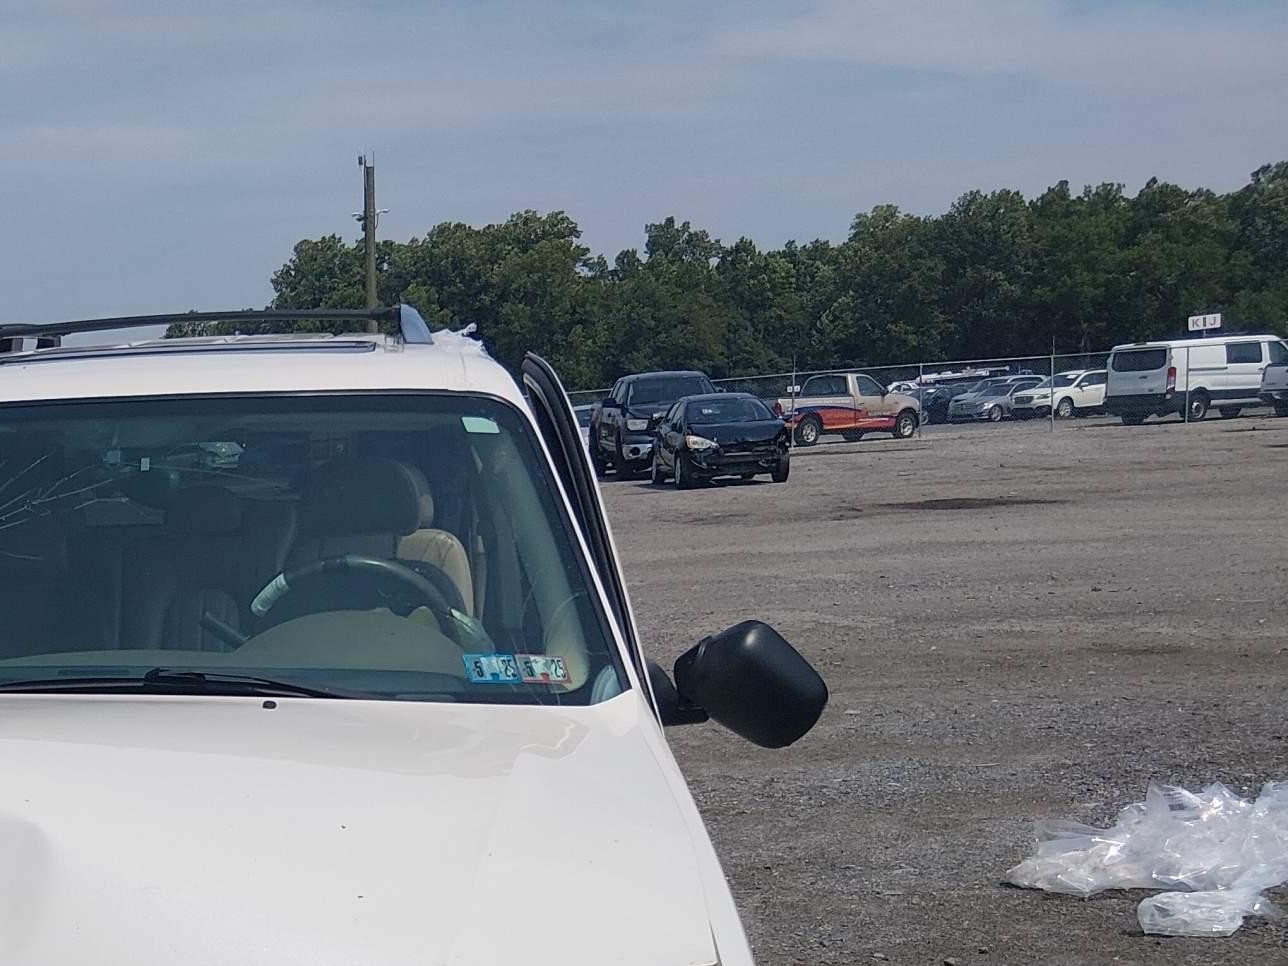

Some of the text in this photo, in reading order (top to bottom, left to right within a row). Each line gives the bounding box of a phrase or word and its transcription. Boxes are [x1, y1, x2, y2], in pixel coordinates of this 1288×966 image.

[1191, 317, 1216, 329] K J
[473, 659, 517, 678] 5 25
[551, 659, 567, 678] 25
